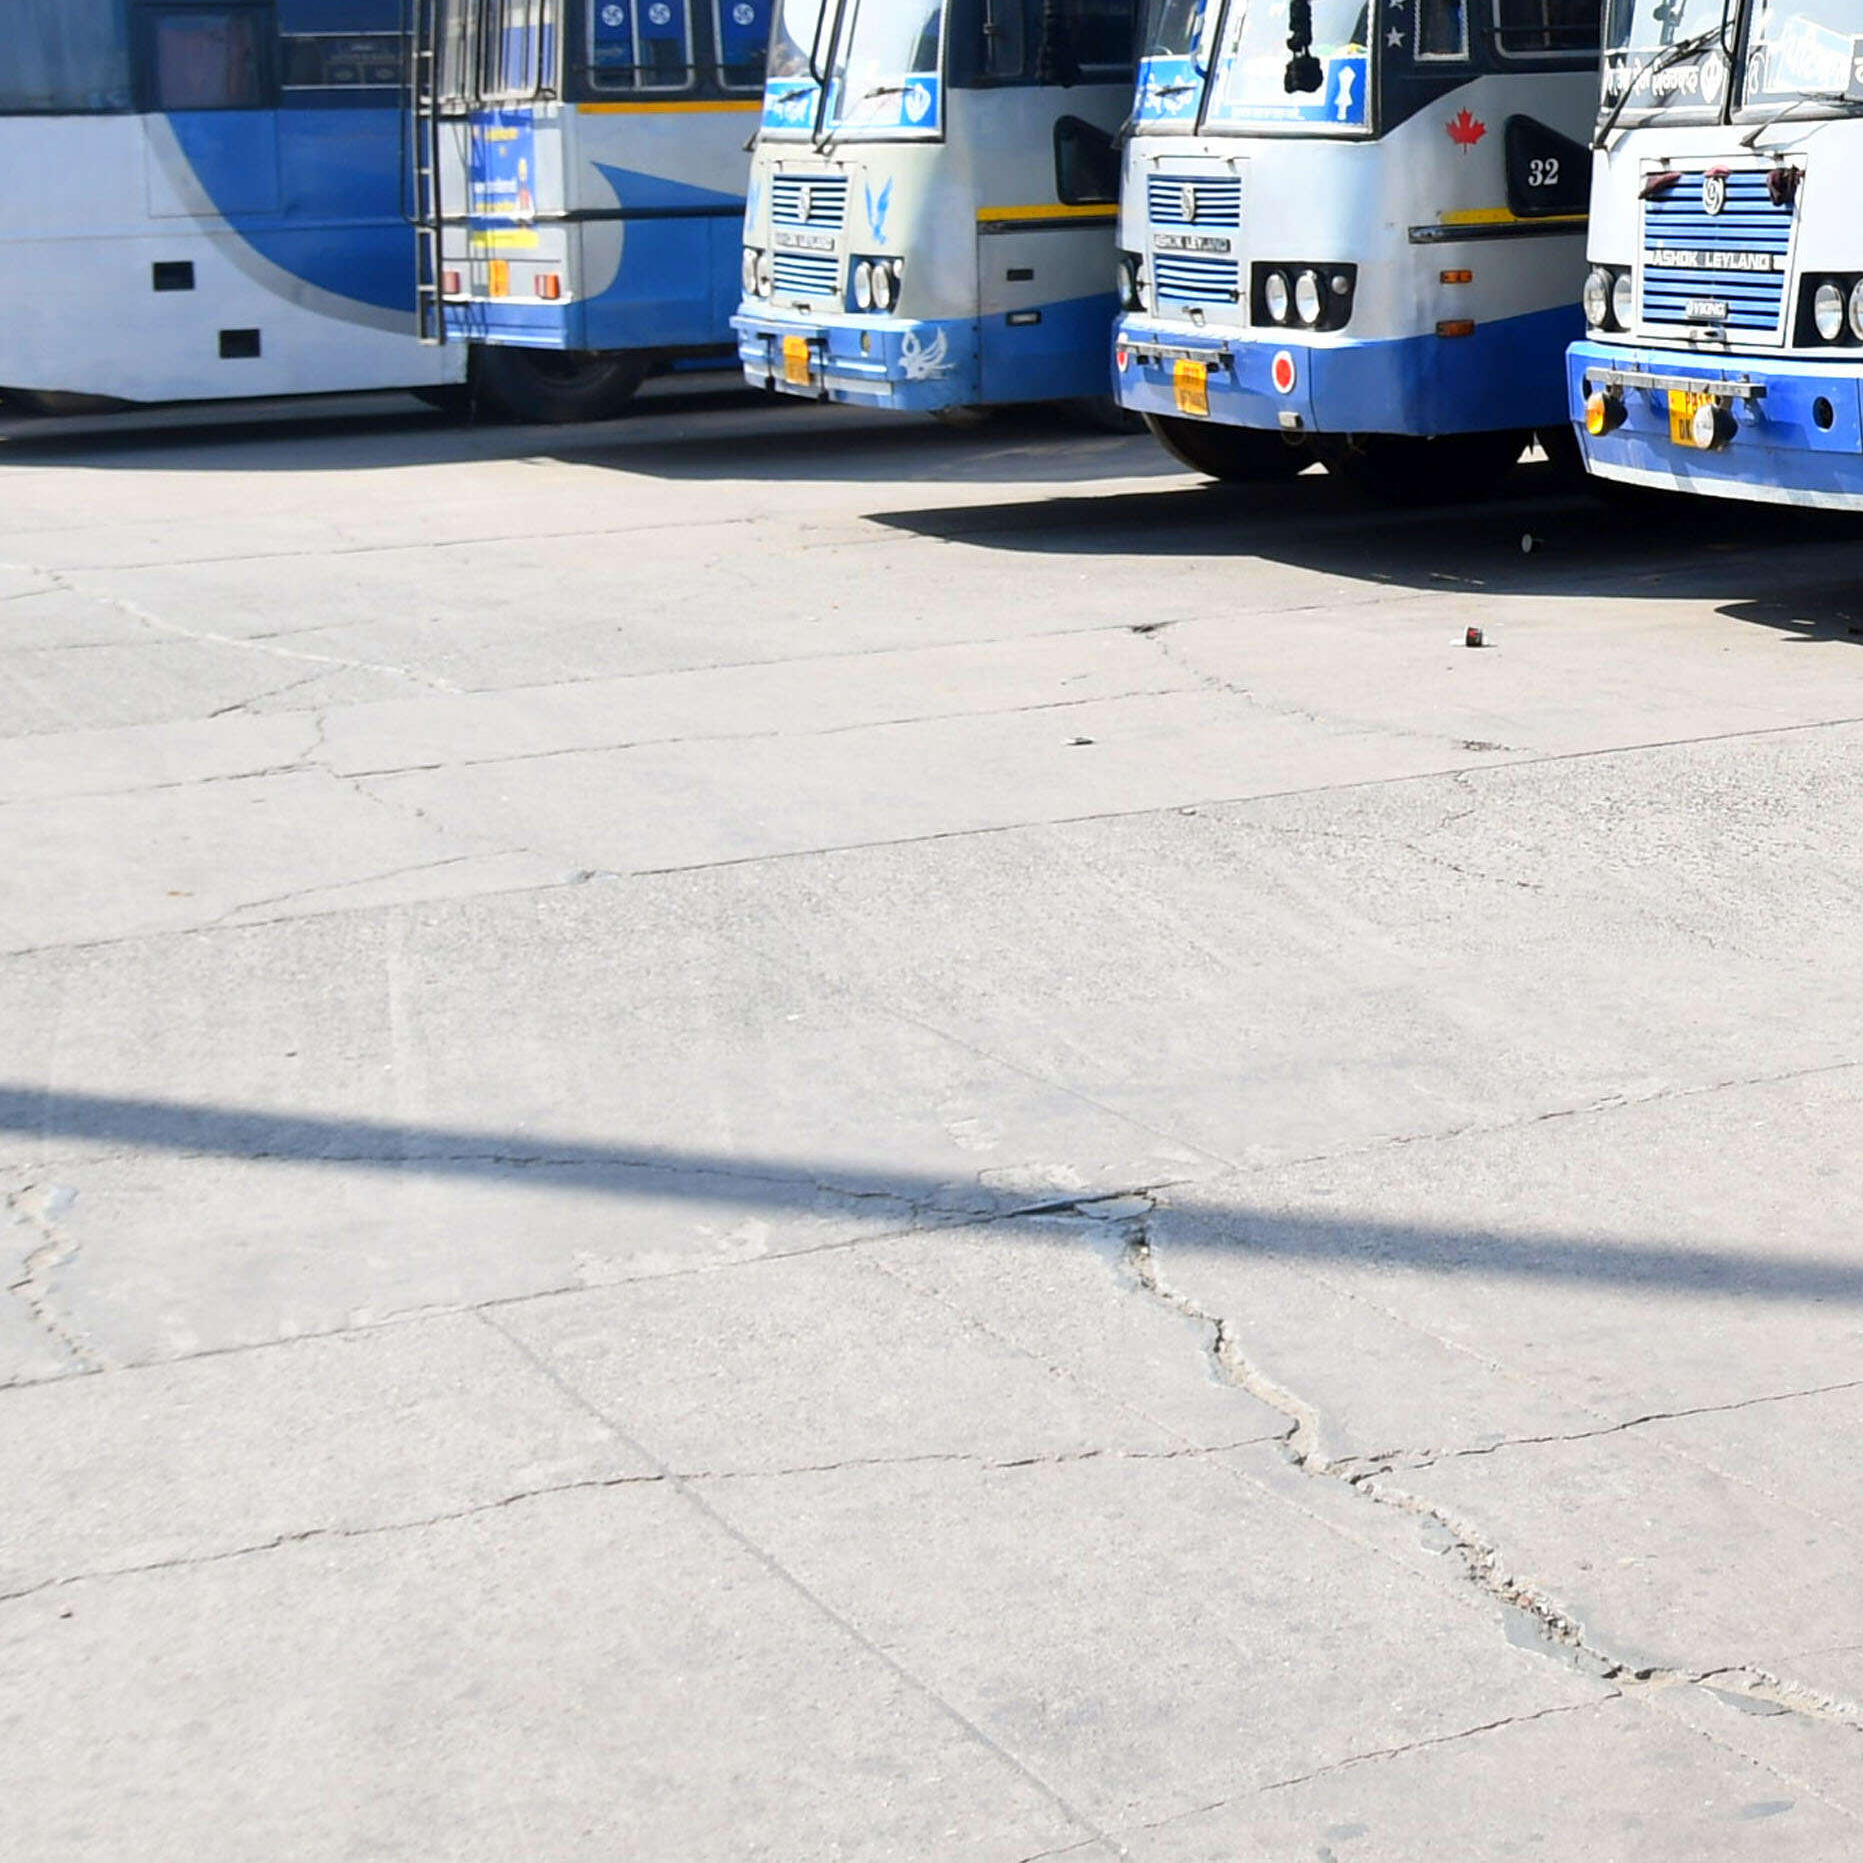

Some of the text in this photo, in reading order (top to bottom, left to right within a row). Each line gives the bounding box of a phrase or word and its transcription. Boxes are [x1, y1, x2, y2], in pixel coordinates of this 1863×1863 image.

[1528, 158, 1559, 186] 32
[1653, 249, 1771, 271] ASHOK LEYLAND
